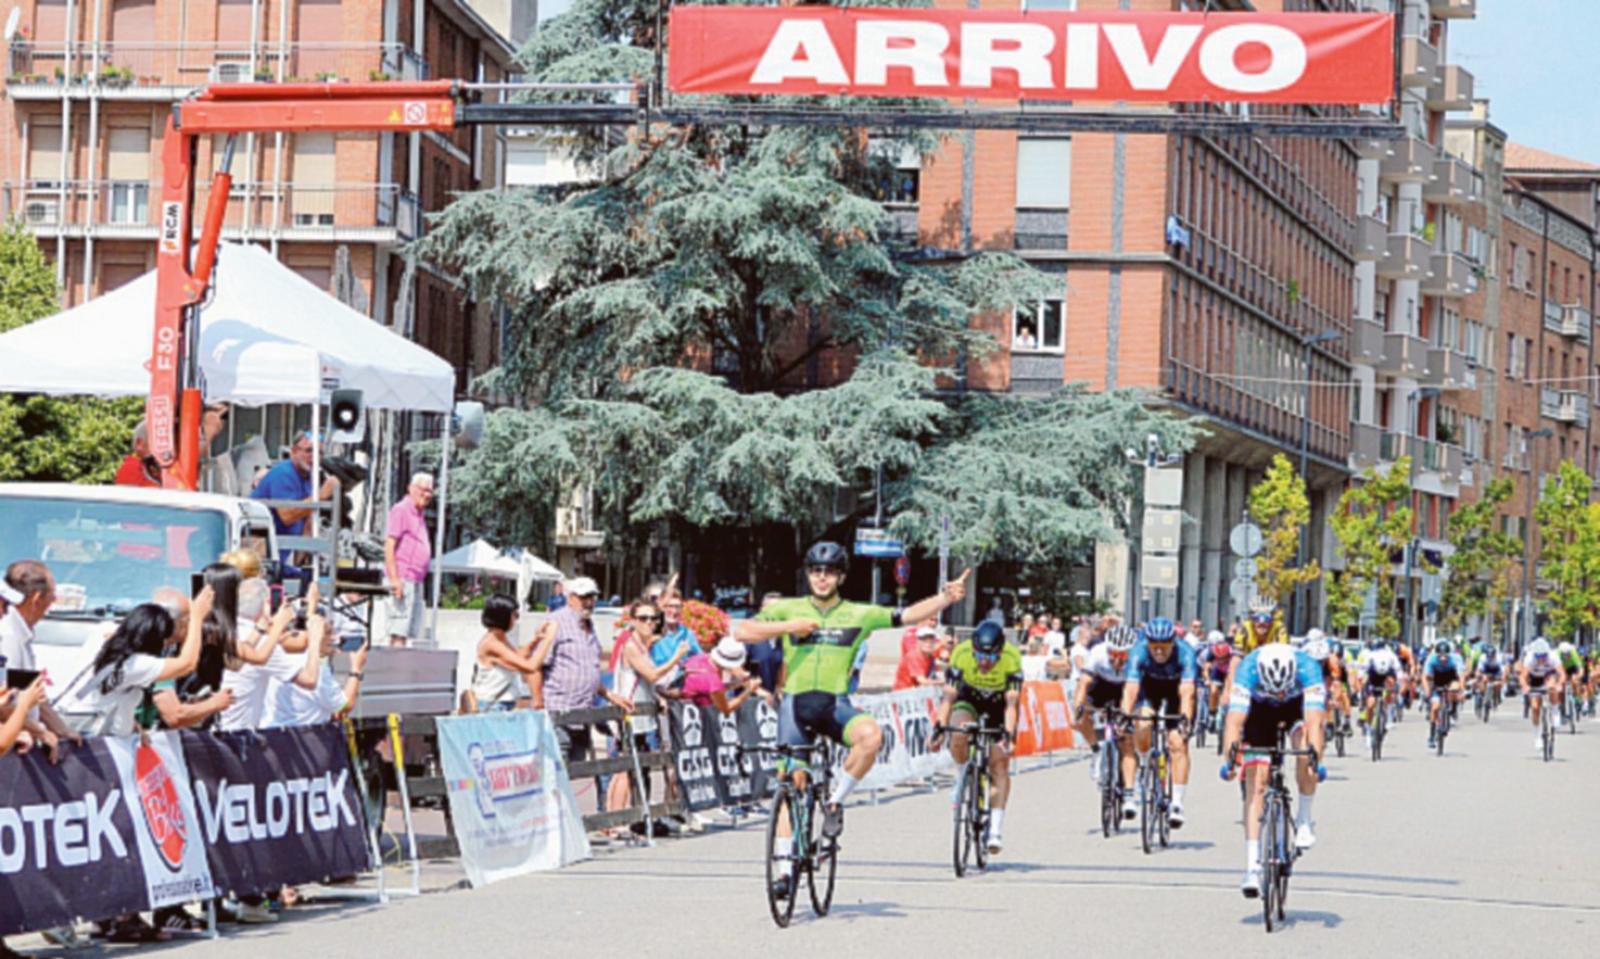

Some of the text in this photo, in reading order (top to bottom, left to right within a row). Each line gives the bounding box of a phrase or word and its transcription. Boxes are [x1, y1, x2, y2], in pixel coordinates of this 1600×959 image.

[749, 18, 1308, 93] ARRIVO
[678, 747, 714, 781] GSG
[0, 789, 128, 873] OTEK
[195, 768, 357, 845] VELOTEK
